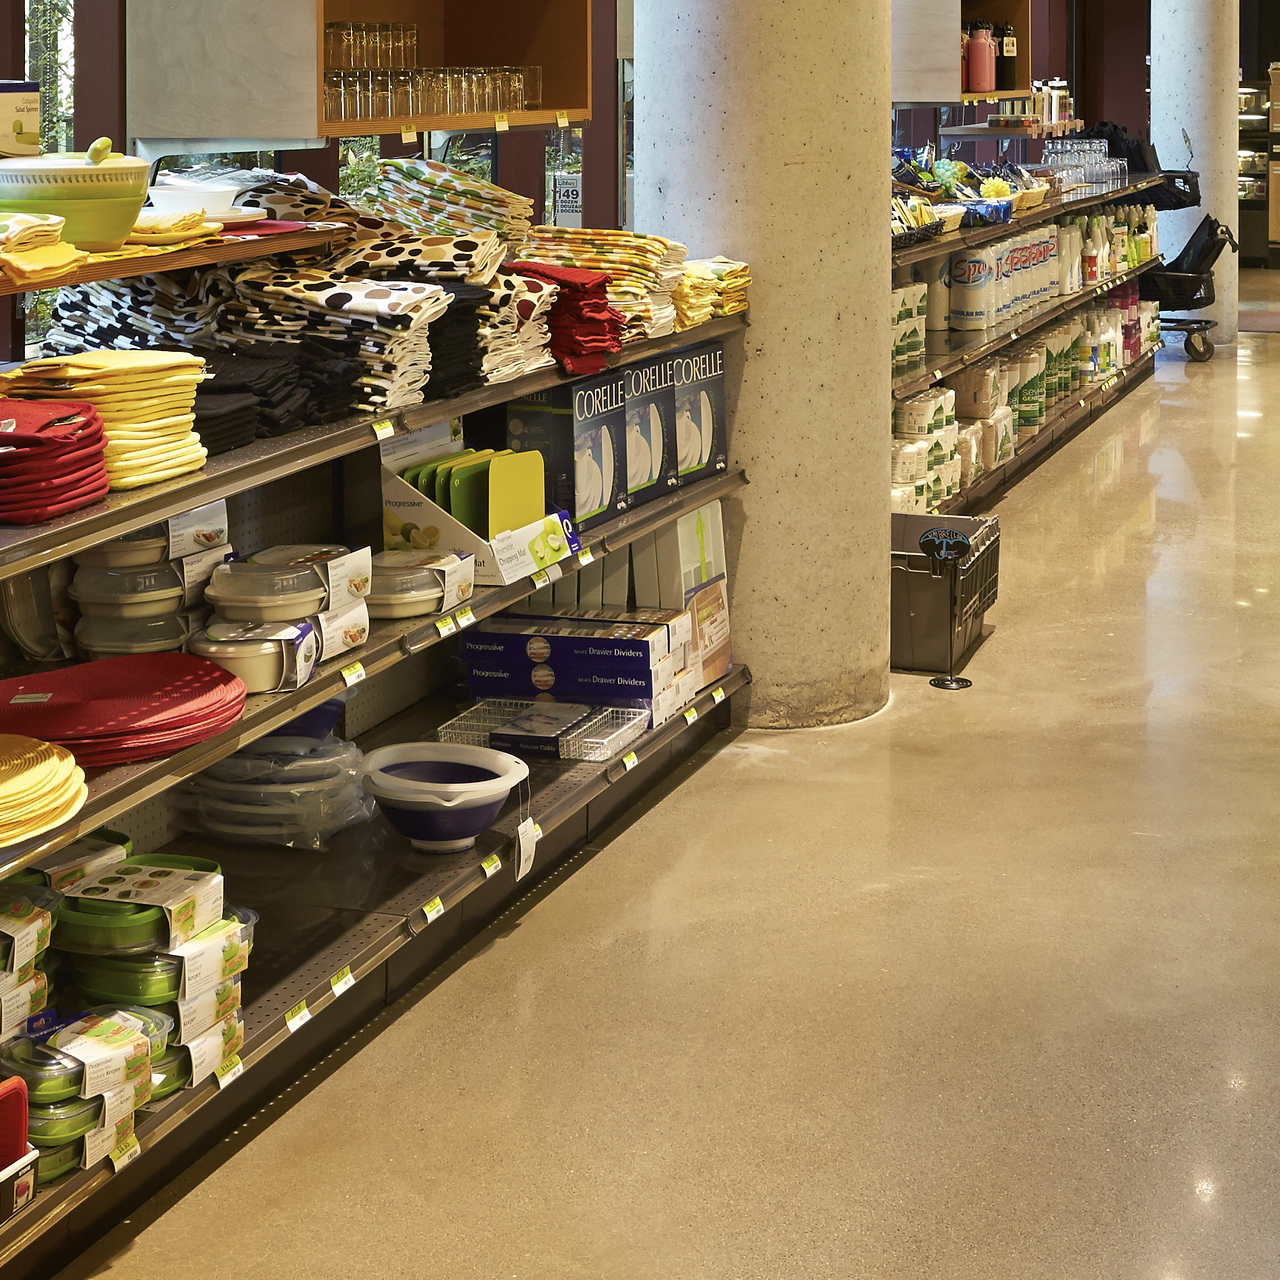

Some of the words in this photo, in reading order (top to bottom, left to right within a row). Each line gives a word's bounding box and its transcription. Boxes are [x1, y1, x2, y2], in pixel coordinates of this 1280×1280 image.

[673, 351, 723, 386] CORELLE
[625, 361, 673, 399] CORELLE
[575, 380, 624, 421] CORELLE
[385, 499, 423, 508] Progressive
[518, 548, 527, 558] Mat
[467, 643, 505, 652] Progressive
[588, 647, 612, 656] Drawer
[614, 649, 643, 658] Dividers
